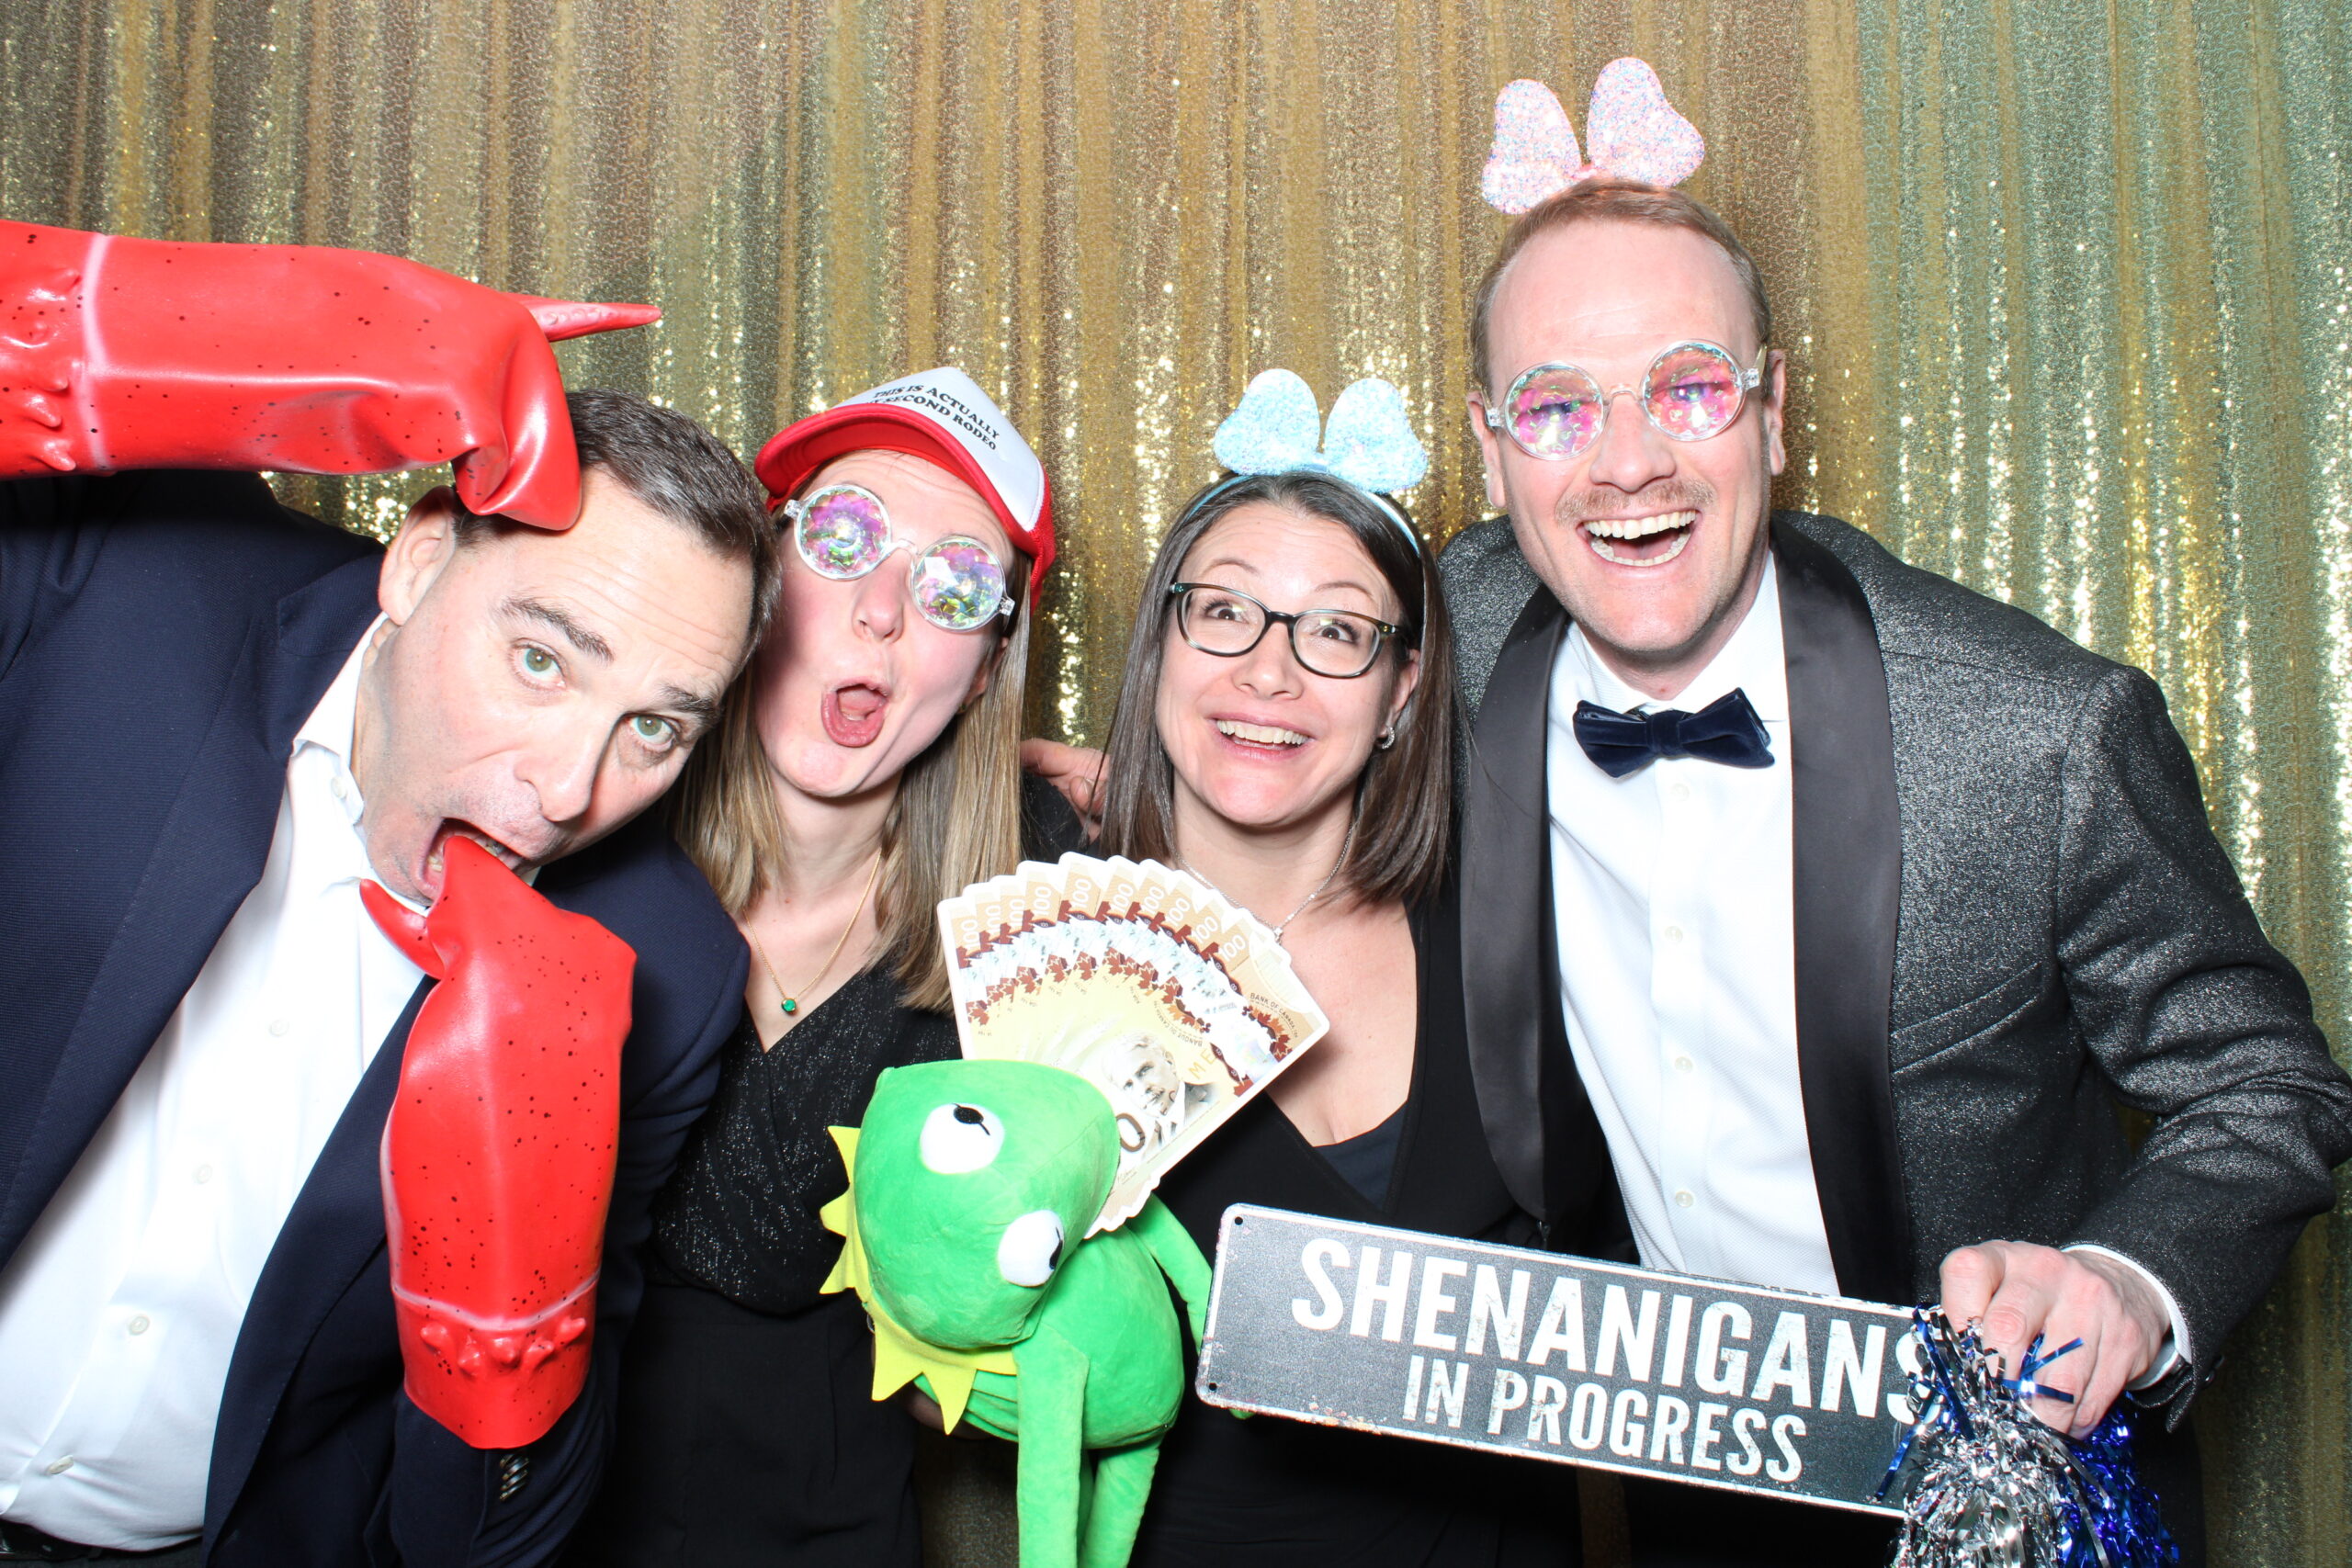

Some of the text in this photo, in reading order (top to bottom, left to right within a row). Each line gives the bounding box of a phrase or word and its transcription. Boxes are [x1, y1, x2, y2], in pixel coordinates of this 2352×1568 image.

[874, 384, 1000, 439] THIS IS ACTUALLY
[882, 394, 997, 451] SECOND RODEO
[1033, 886, 1053, 916] 100
[1071, 877, 1092, 908] 100
[1111, 883, 1135, 913] 100
[1141, 886, 1166, 914] 100
[1165, 897, 1191, 927] 100
[1194, 916, 1219, 944] 100
[1219, 934, 1247, 962] 100
[1250, 992, 1269, 1005] BANK
[1402, 1354, 1807, 1483] IN PROGRESS
